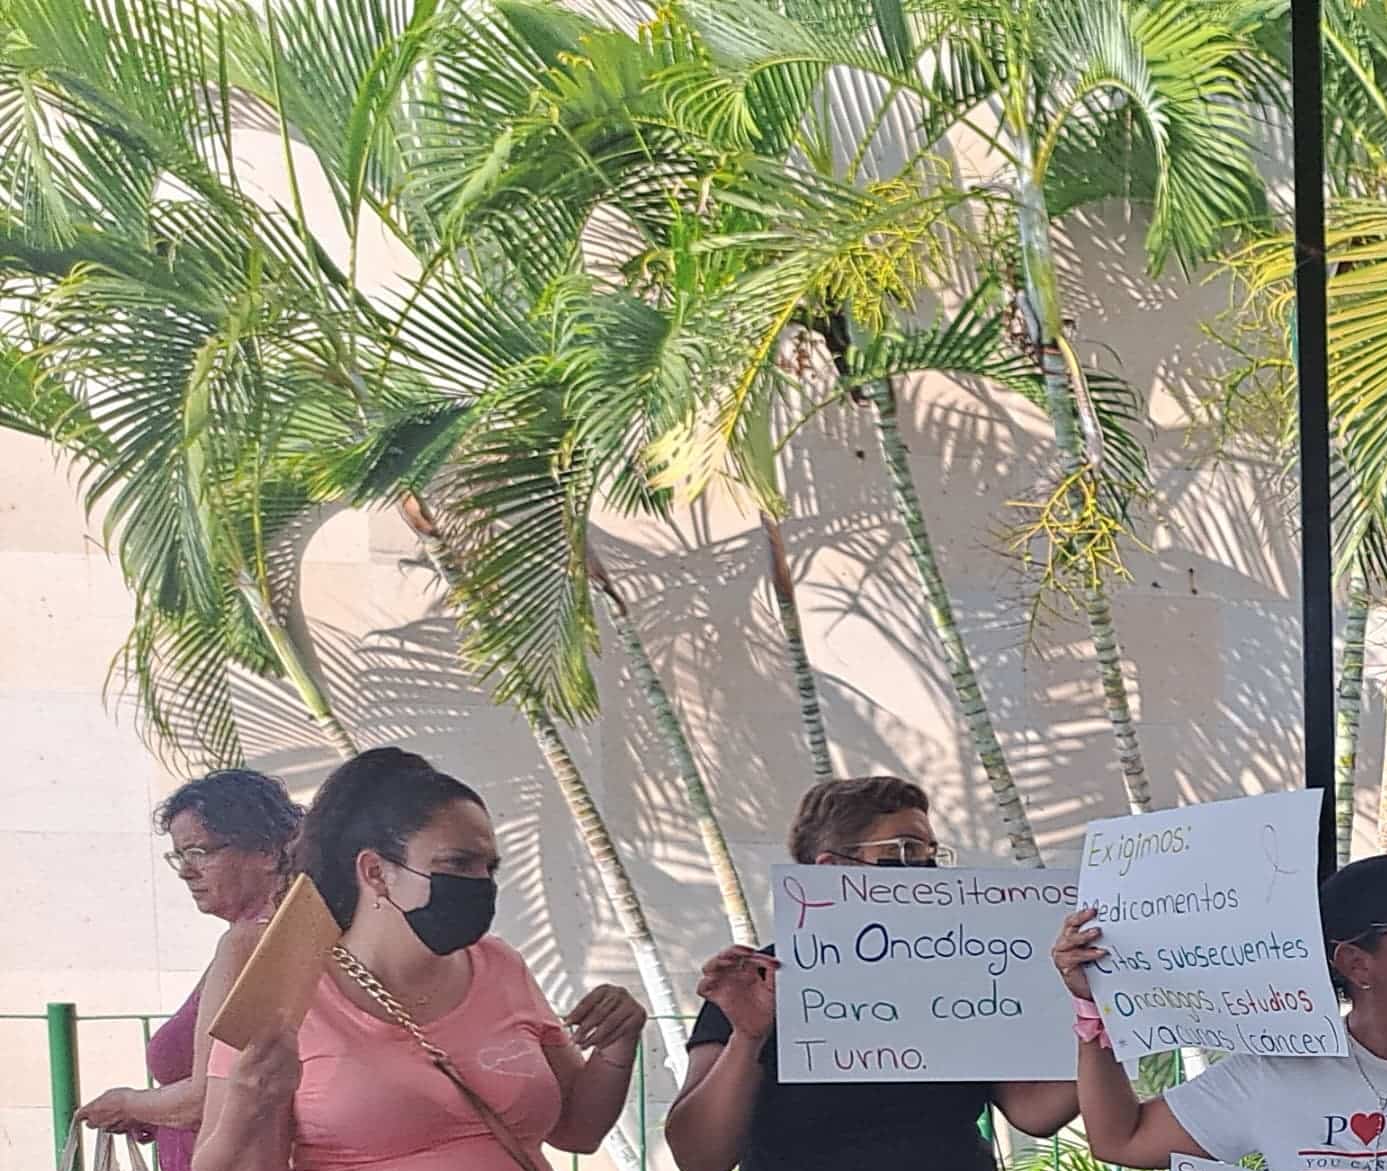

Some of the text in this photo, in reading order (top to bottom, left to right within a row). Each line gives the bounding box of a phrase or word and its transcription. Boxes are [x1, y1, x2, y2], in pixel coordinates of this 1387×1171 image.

[1088, 825, 1192, 876] Exigimos:
[841, 874, 1079, 906] Necesitamos
[793, 923, 1034, 976] Un Oncólogo
[801, 979, 1024, 1024] Para cada
[1222, 983, 1314, 1017] Estudios
[795, 1040, 928, 1072] Turno.
[1305, 1158, 1341, 1169] YOU
